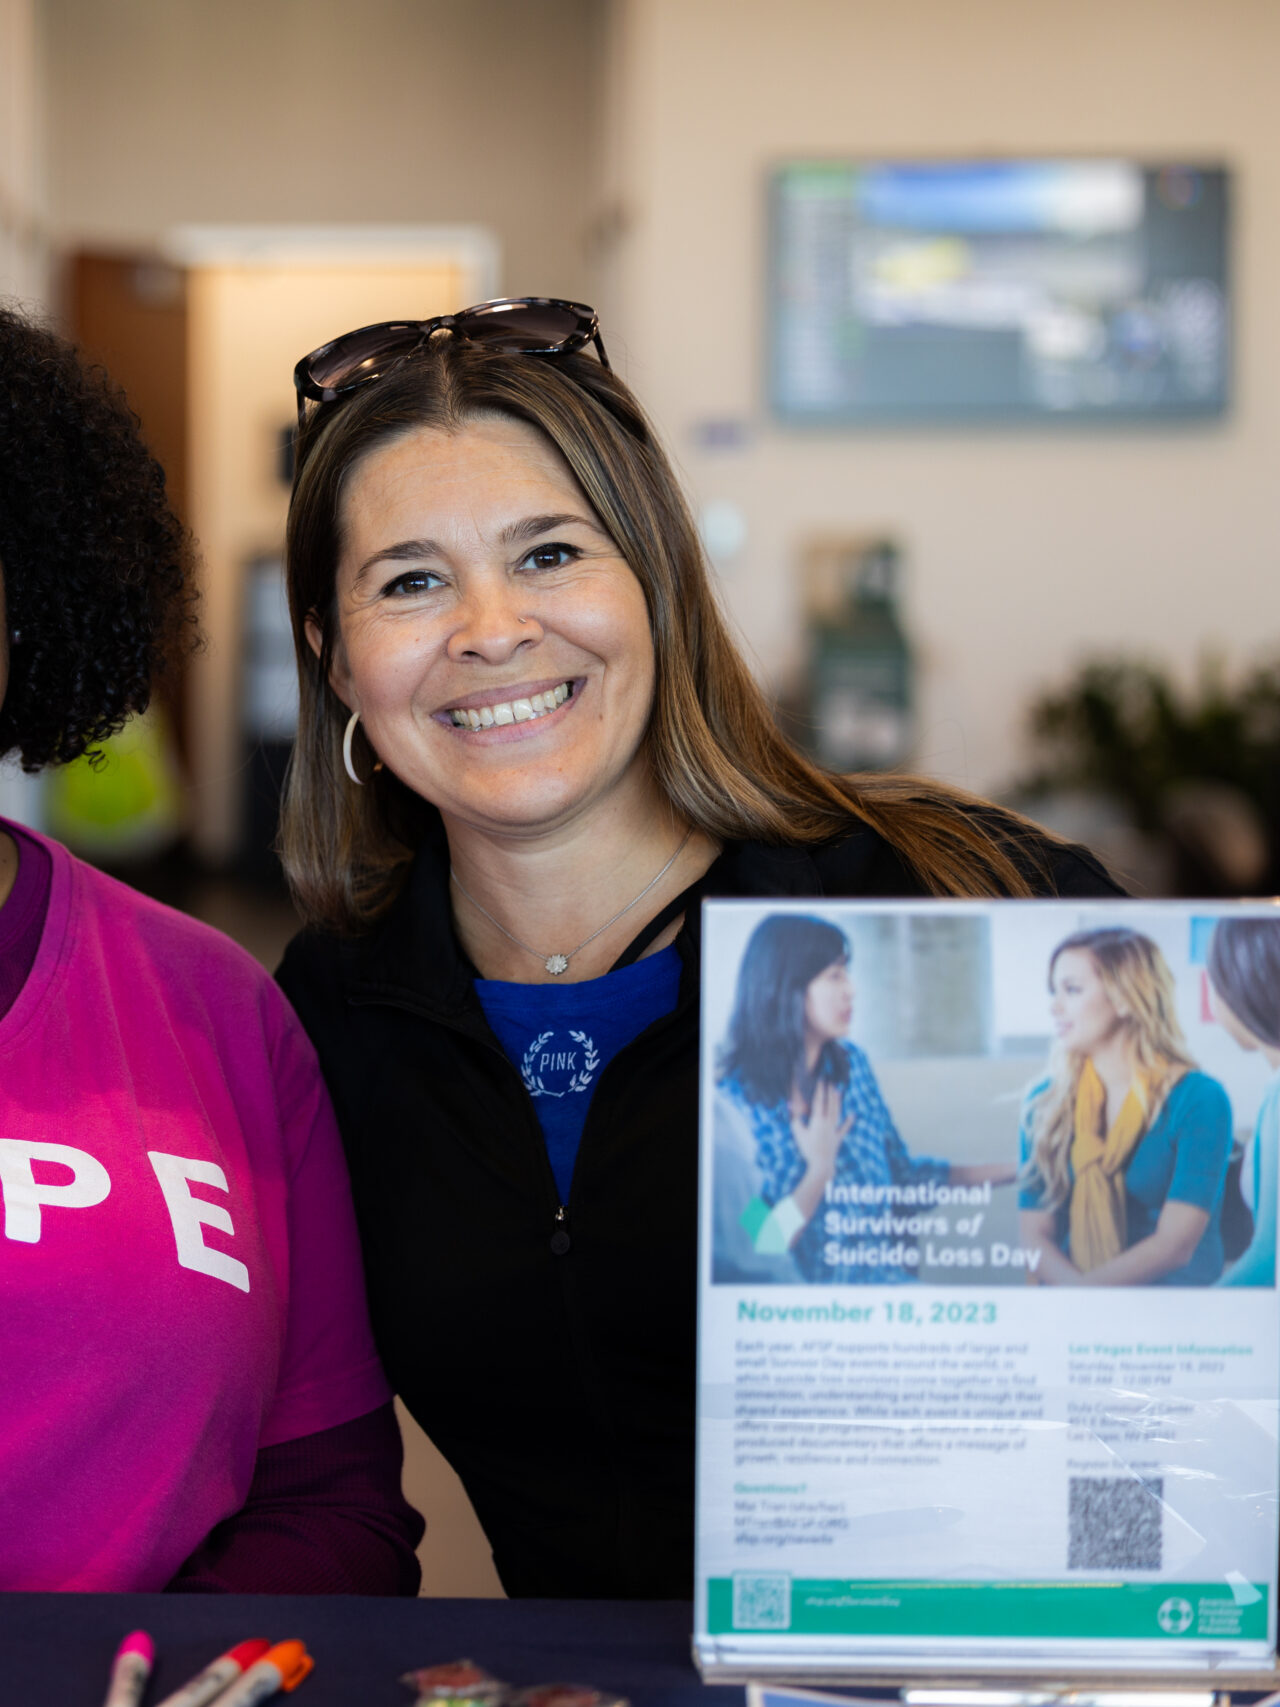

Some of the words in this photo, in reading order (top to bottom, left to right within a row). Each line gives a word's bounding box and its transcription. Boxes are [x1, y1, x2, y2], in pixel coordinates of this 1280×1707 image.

[539, 1051, 577, 1073] PINK
[824, 1180, 992, 1206] International
[823, 1211, 949, 1236] Survivors
[955, 1211, 984, 1239] of
[823, 1242, 920, 1268] Suicide
[925, 1242, 985, 1268] Loss
[990, 1242, 1042, 1272] Day
[736, 1300, 874, 1324] November
[883, 1300, 923, 1326] 18,
[929, 1300, 998, 1324] 2023
[1004, 1340, 1029, 1353] and
[1067, 1343, 1090, 1355] Las
[1093, 1343, 1133, 1357] Vegas
[1136, 1343, 1173, 1355] Event
[1176, 1343, 1254, 1355] Information
[939, 1357, 959, 1369] the
[774, 1373, 816, 1385] suicide
[847, 1373, 900, 1385] survivors
[940, 1373, 993, 1388] together
[1012, 1373, 1037, 1385] find
[808, 1390, 898, 1405] understanding
[902, 1390, 924, 1403] and
[928, 1390, 960, 1406] hope
[963, 1390, 1013, 1405] through
[1015, 1390, 1043, 1403] their
[734, 1405, 777, 1418] shared
[853, 1405, 888, 1418] While
[892, 1405, 921, 1418] each
[974, 1405, 1017, 1421] unique
[1020, 1405, 1043, 1418] and
[798, 1436, 877, 1452] documentary
[881, 1436, 905, 1449] that
[955, 1436, 1010, 1452] message
[845, 1453, 868, 1465] and
[733, 1482, 808, 1495] Questions?
